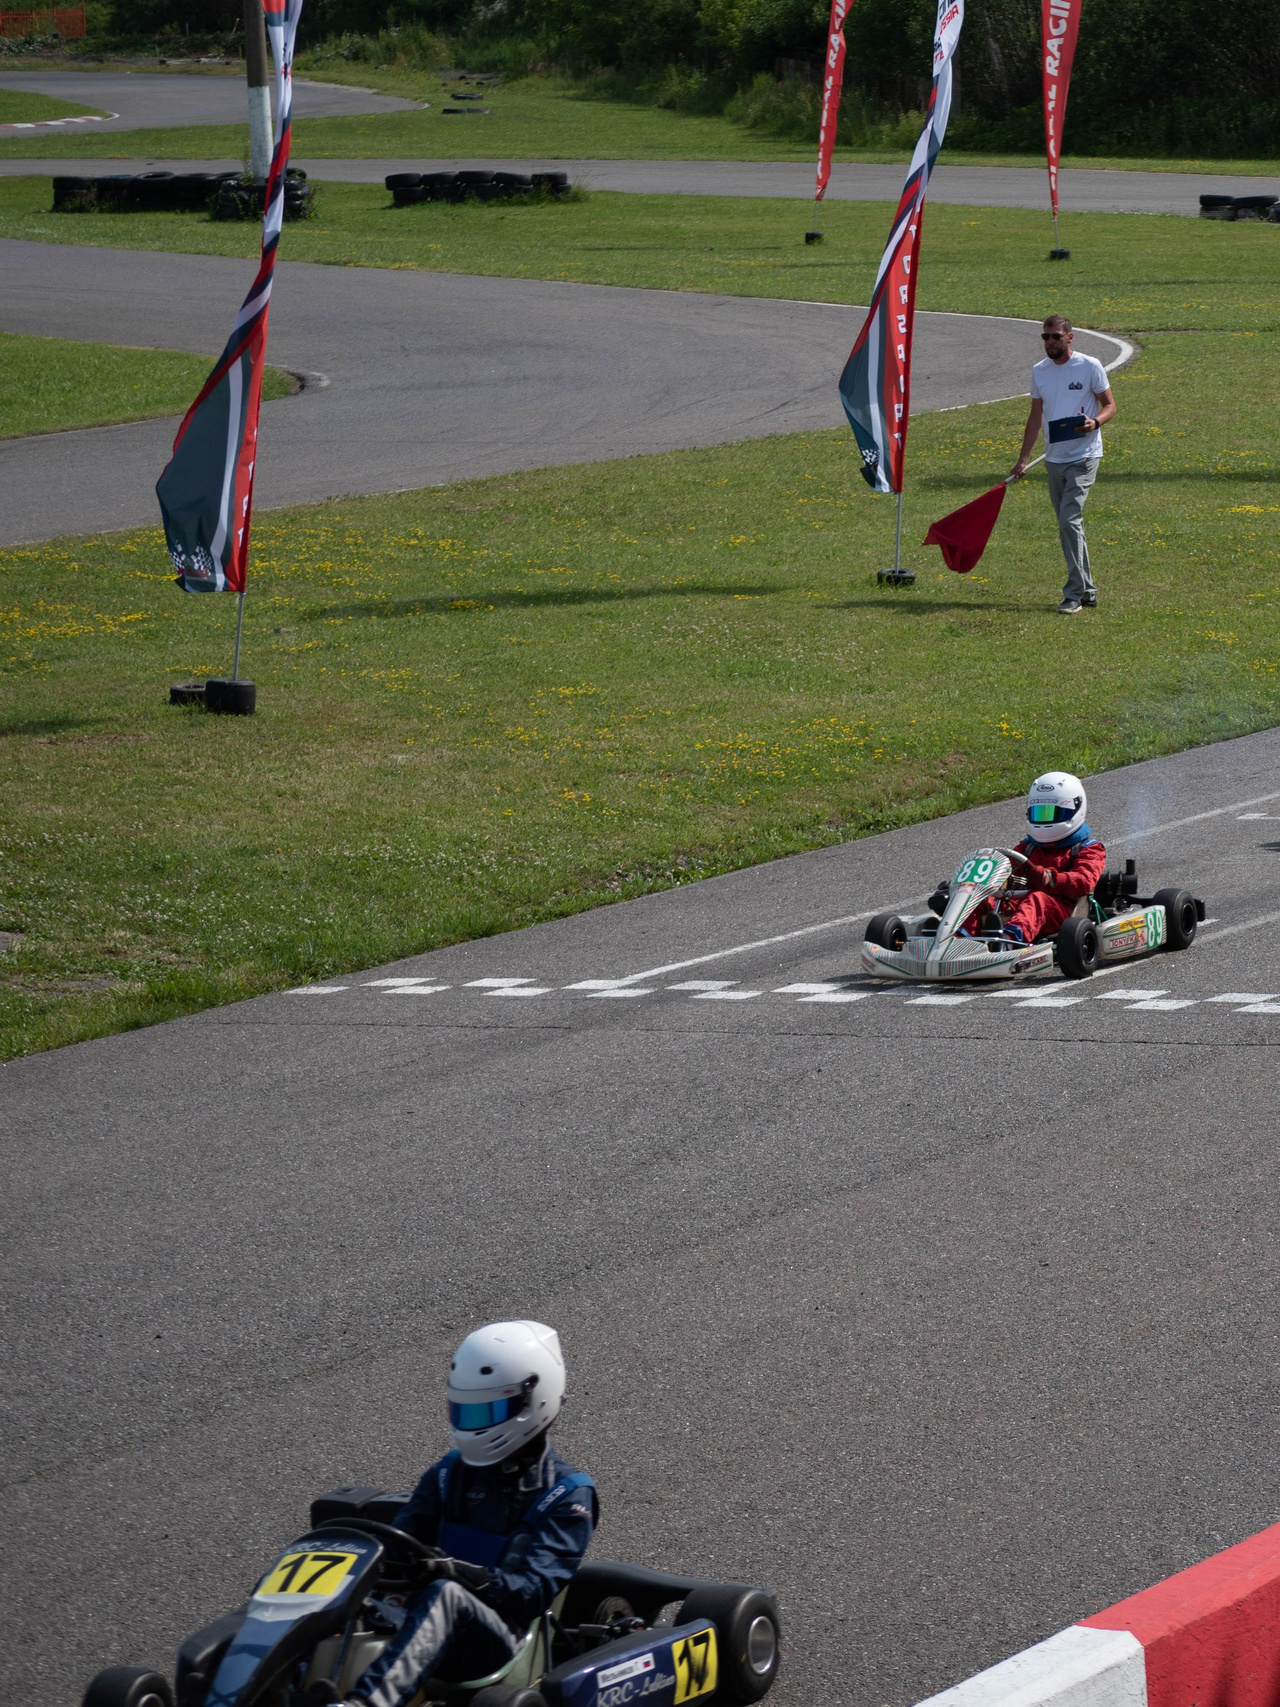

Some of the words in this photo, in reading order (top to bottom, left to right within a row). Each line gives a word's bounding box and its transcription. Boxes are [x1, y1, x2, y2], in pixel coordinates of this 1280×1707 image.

[957, 860, 994, 883] 89
[1147, 910, 1162, 947] 89
[278, 1553, 348, 1593] 17
[678, 1631, 710, 1698] 17
